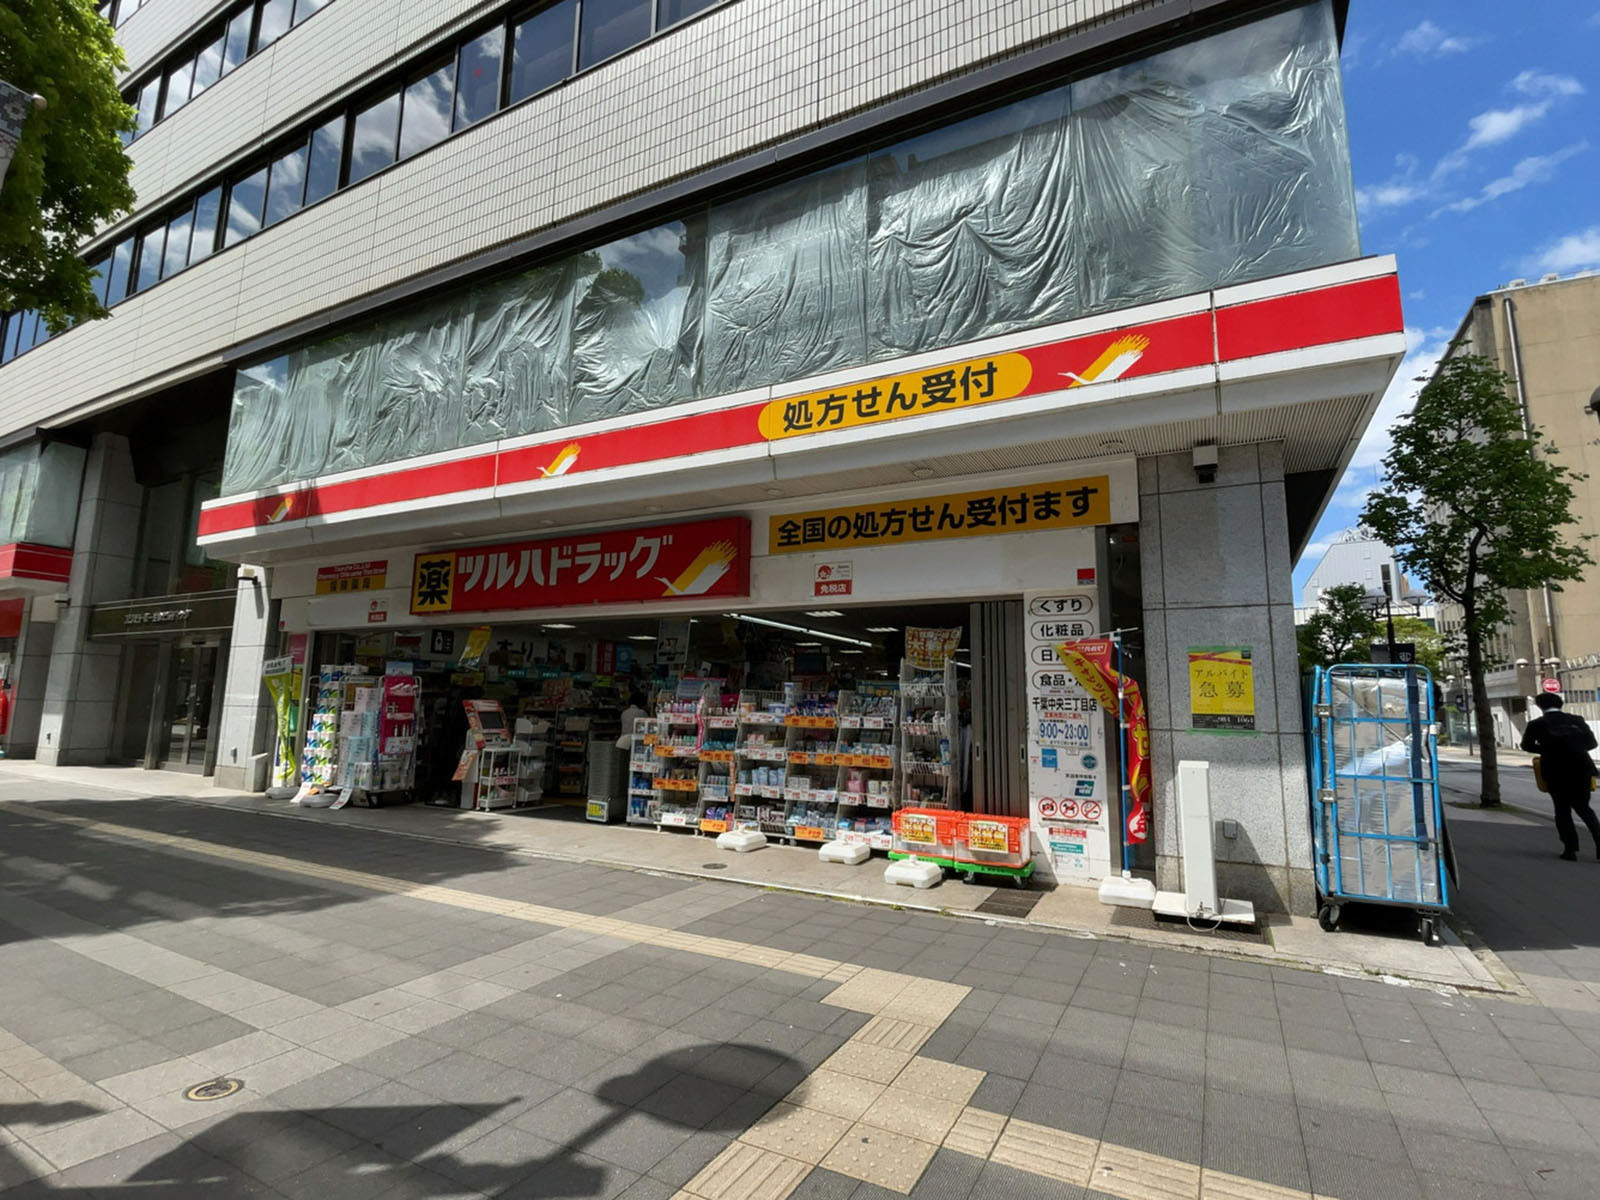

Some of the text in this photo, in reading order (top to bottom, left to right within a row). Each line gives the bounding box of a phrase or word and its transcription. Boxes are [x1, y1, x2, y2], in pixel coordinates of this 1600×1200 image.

[783, 361, 998, 432] 処方せん受付
[777, 486, 1098, 547] 全国の処方せん受付ます
[458, 535, 673, 592] ツルハドラッグ
[417, 559, 451, 606] 薬
[820, 582, 847, 594] 免税店
[1040, 599, 1082, 613] くすり
[1040, 624, 1084, 637] 化粧品
[1042, 650, 1061, 662] 日
[1195, 669, 1248, 679] アルバイト
[1200, 681, 1245, 698] 急募
